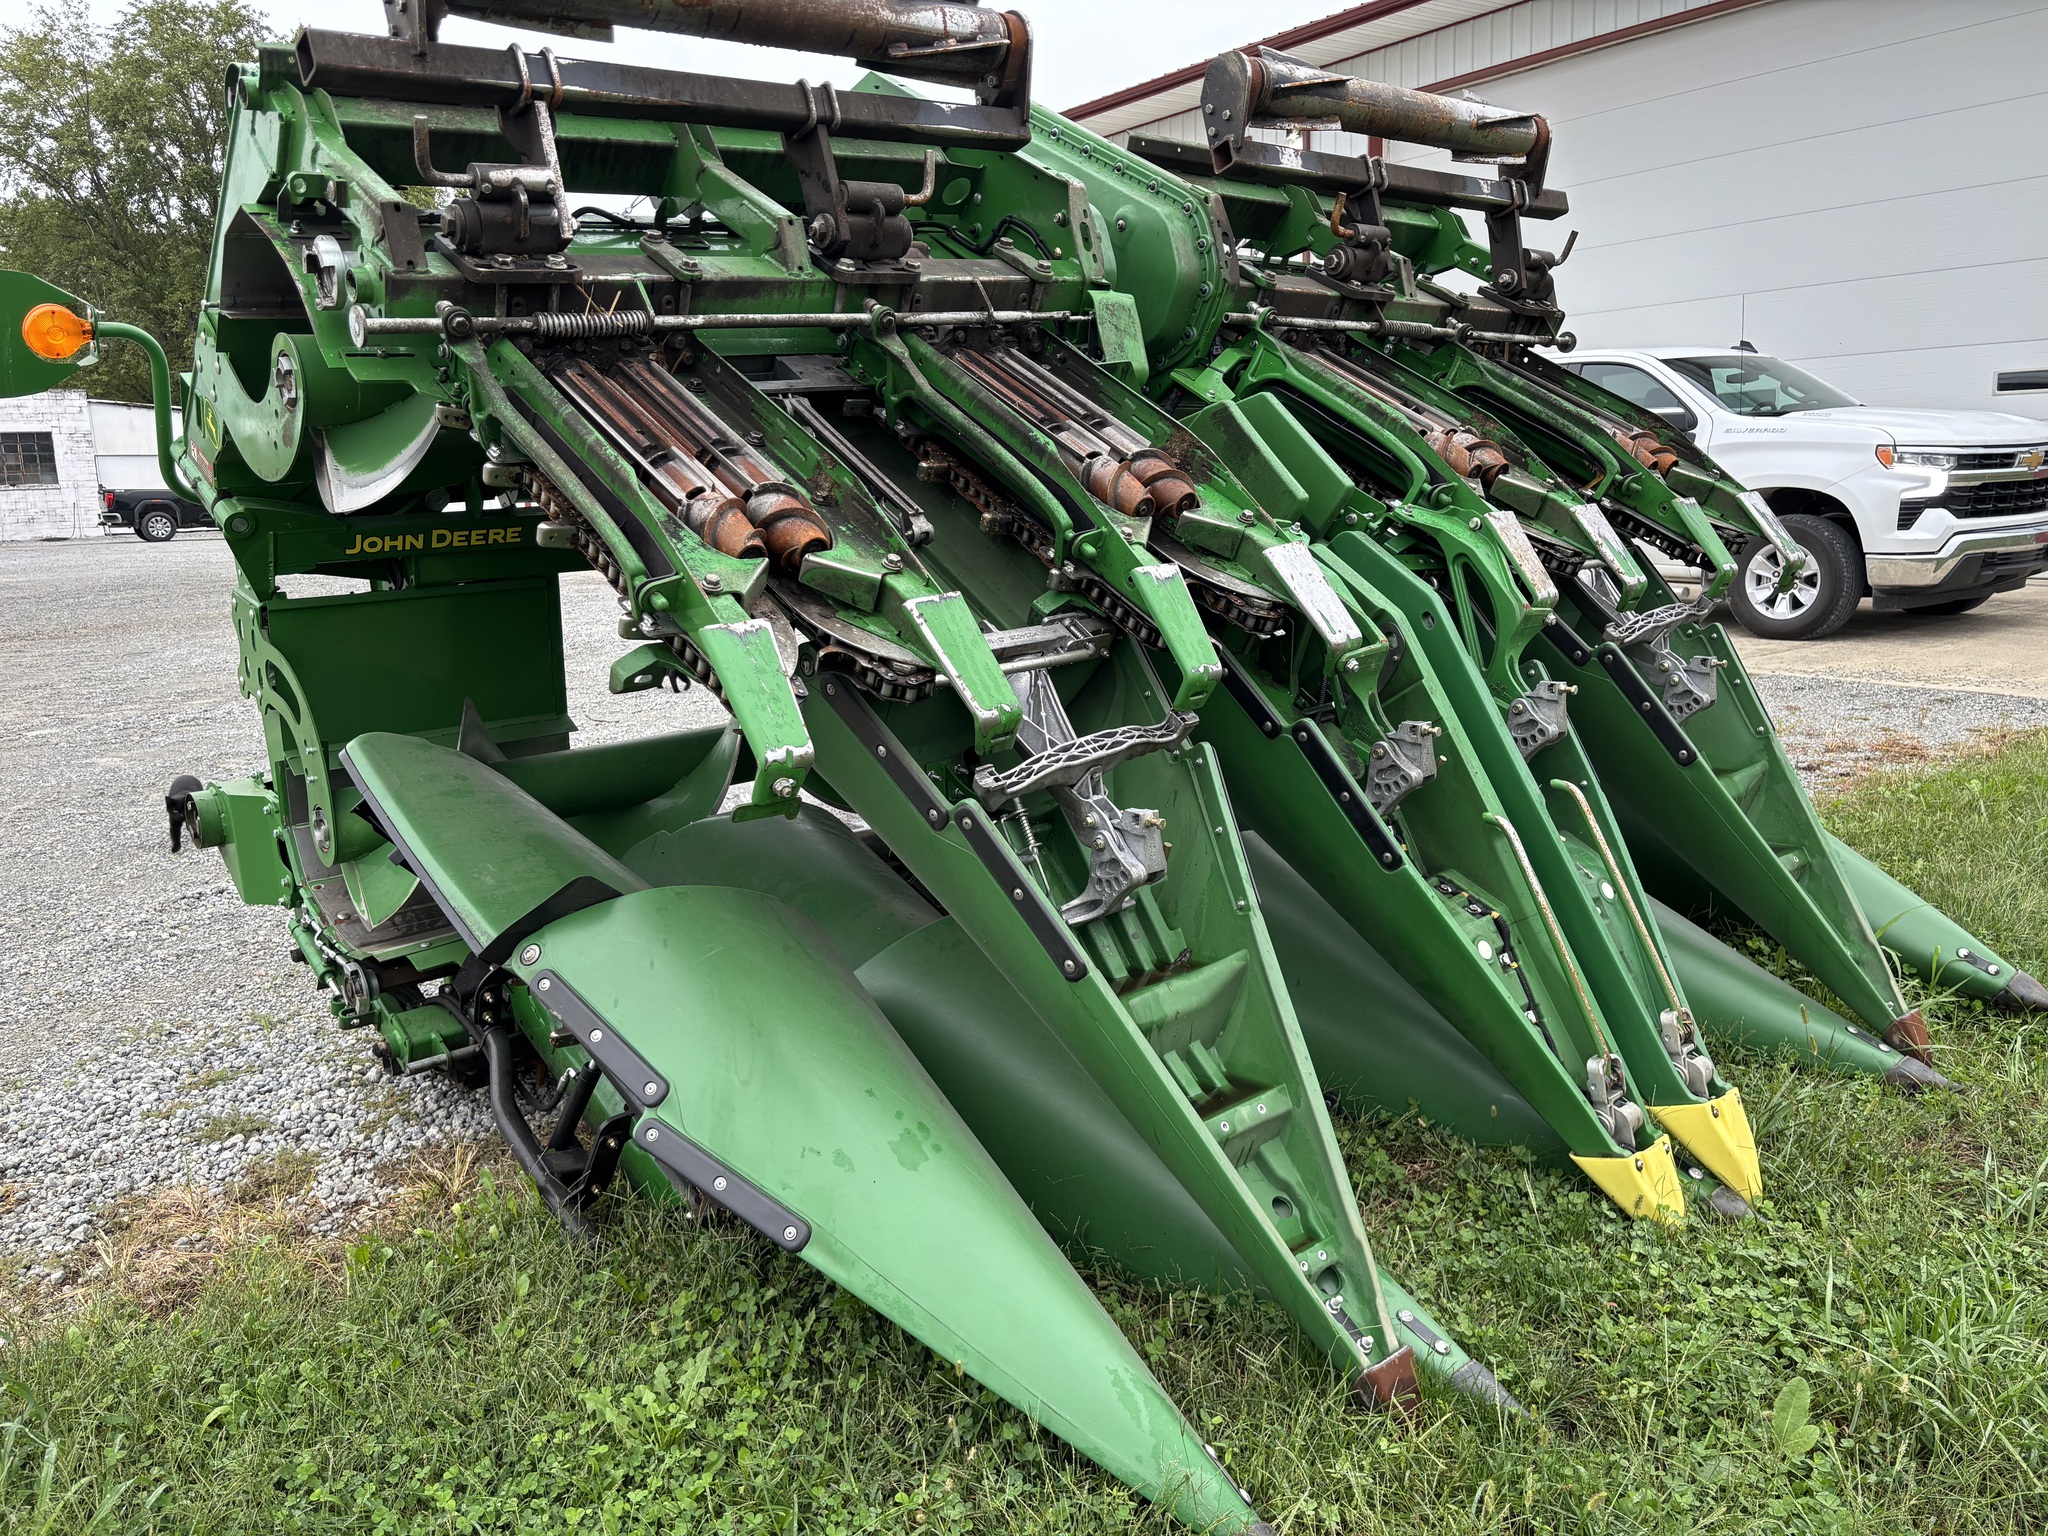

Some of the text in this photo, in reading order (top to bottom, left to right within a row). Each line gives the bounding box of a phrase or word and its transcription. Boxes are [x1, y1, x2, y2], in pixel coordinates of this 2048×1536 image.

[1724, 427, 1788, 435] SILVERADO
[345, 527, 522, 555] JOHN DEERE
